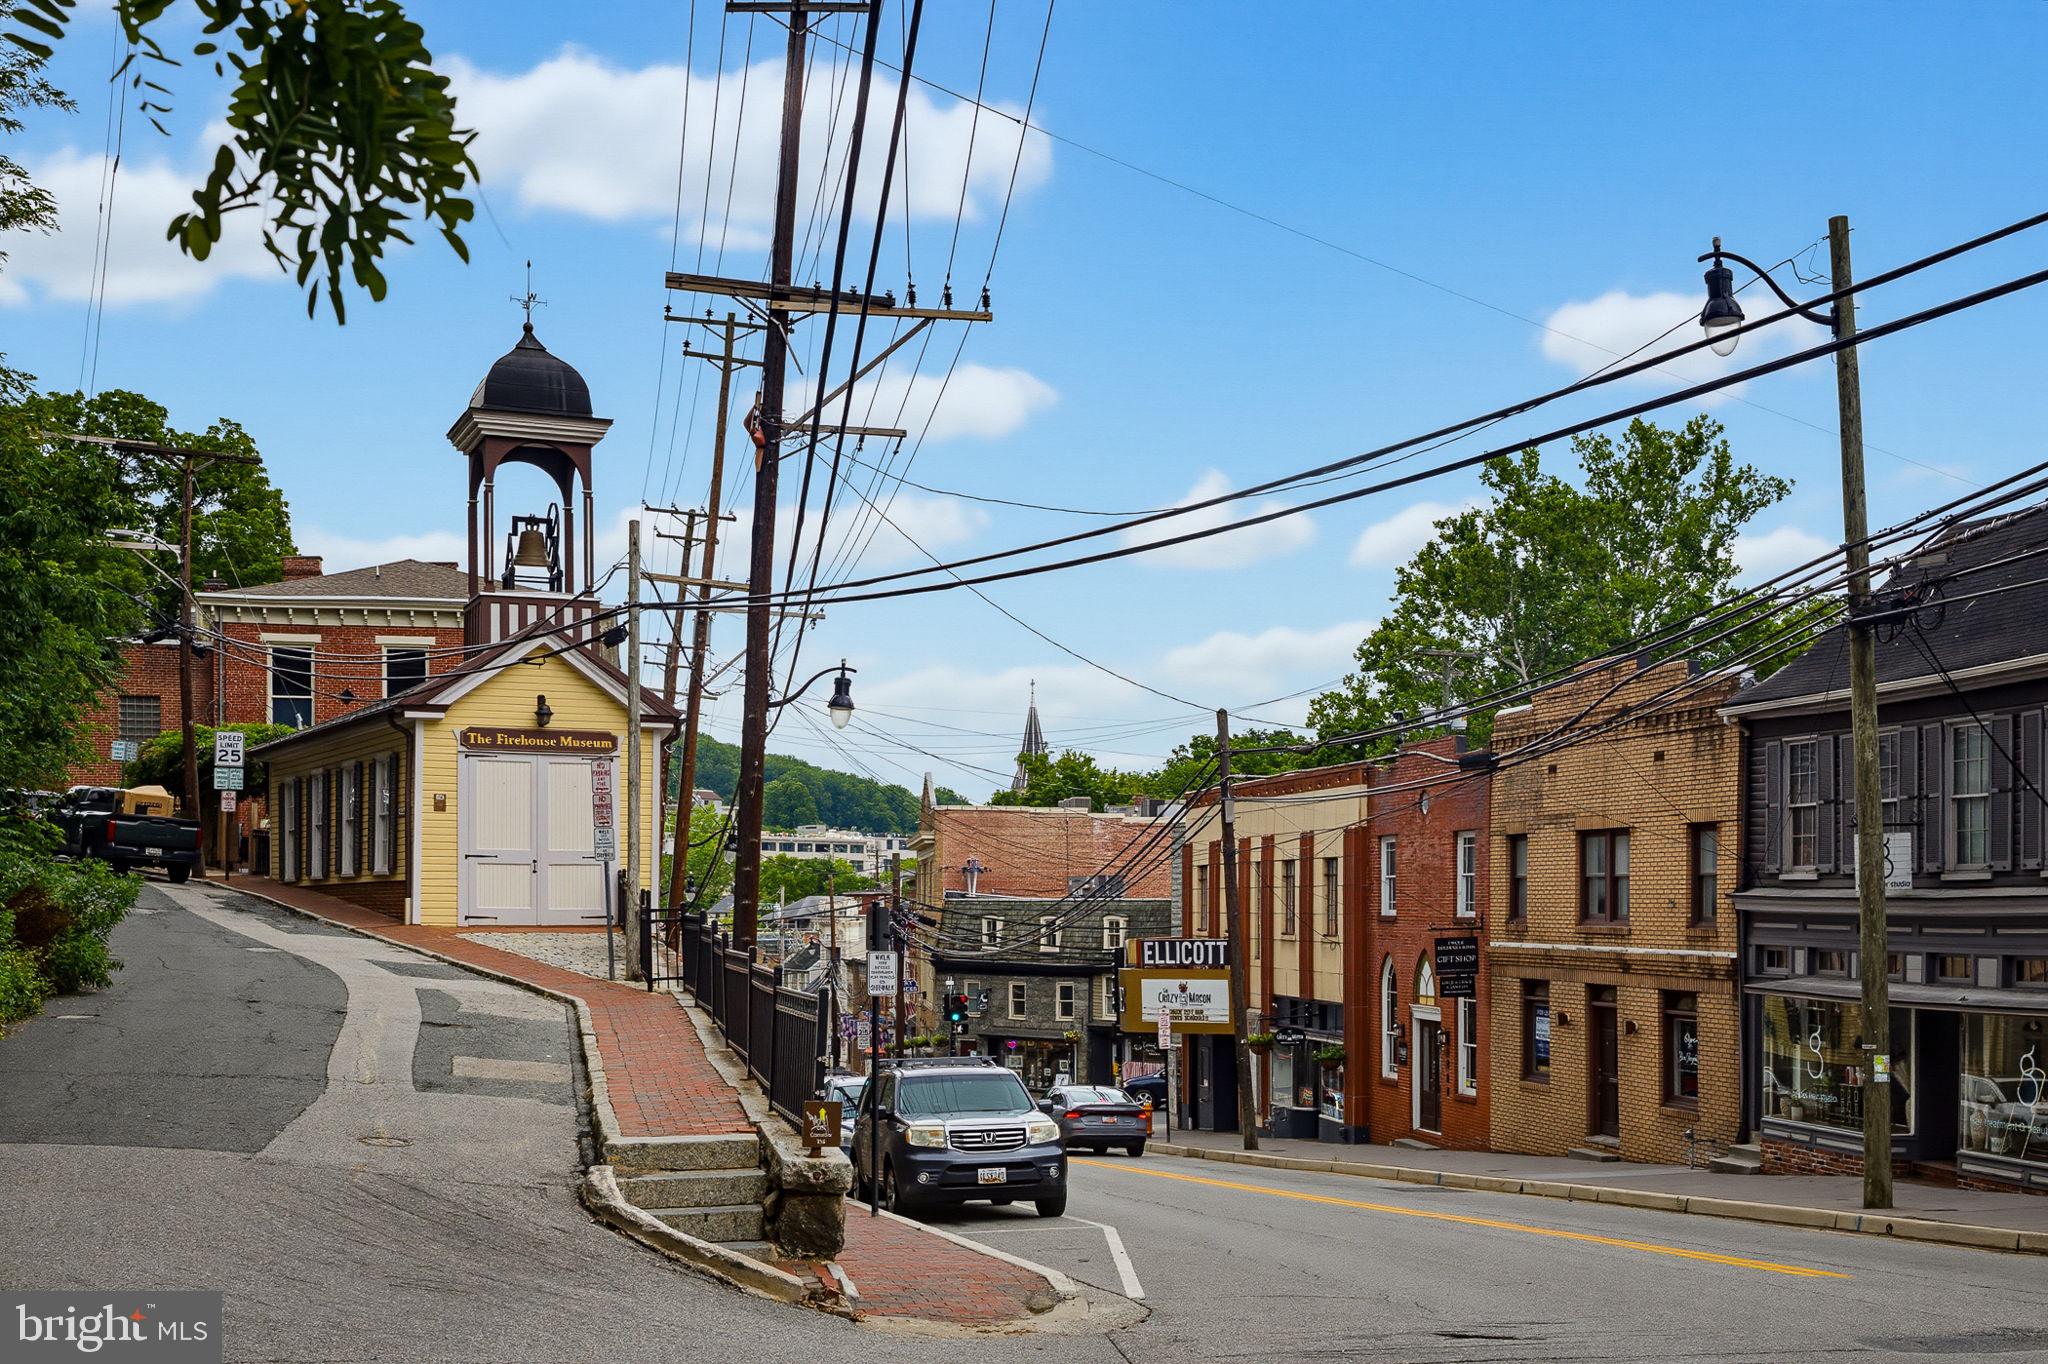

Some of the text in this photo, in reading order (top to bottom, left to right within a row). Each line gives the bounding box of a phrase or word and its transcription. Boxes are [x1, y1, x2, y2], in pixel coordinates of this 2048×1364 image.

[466, 732, 613, 748] The Firehouse Museum
[218, 749, 241, 762] 25
[1143, 941, 1228, 965] ELLICOTT
[1437, 954, 1477, 963] GIFT SHOP
